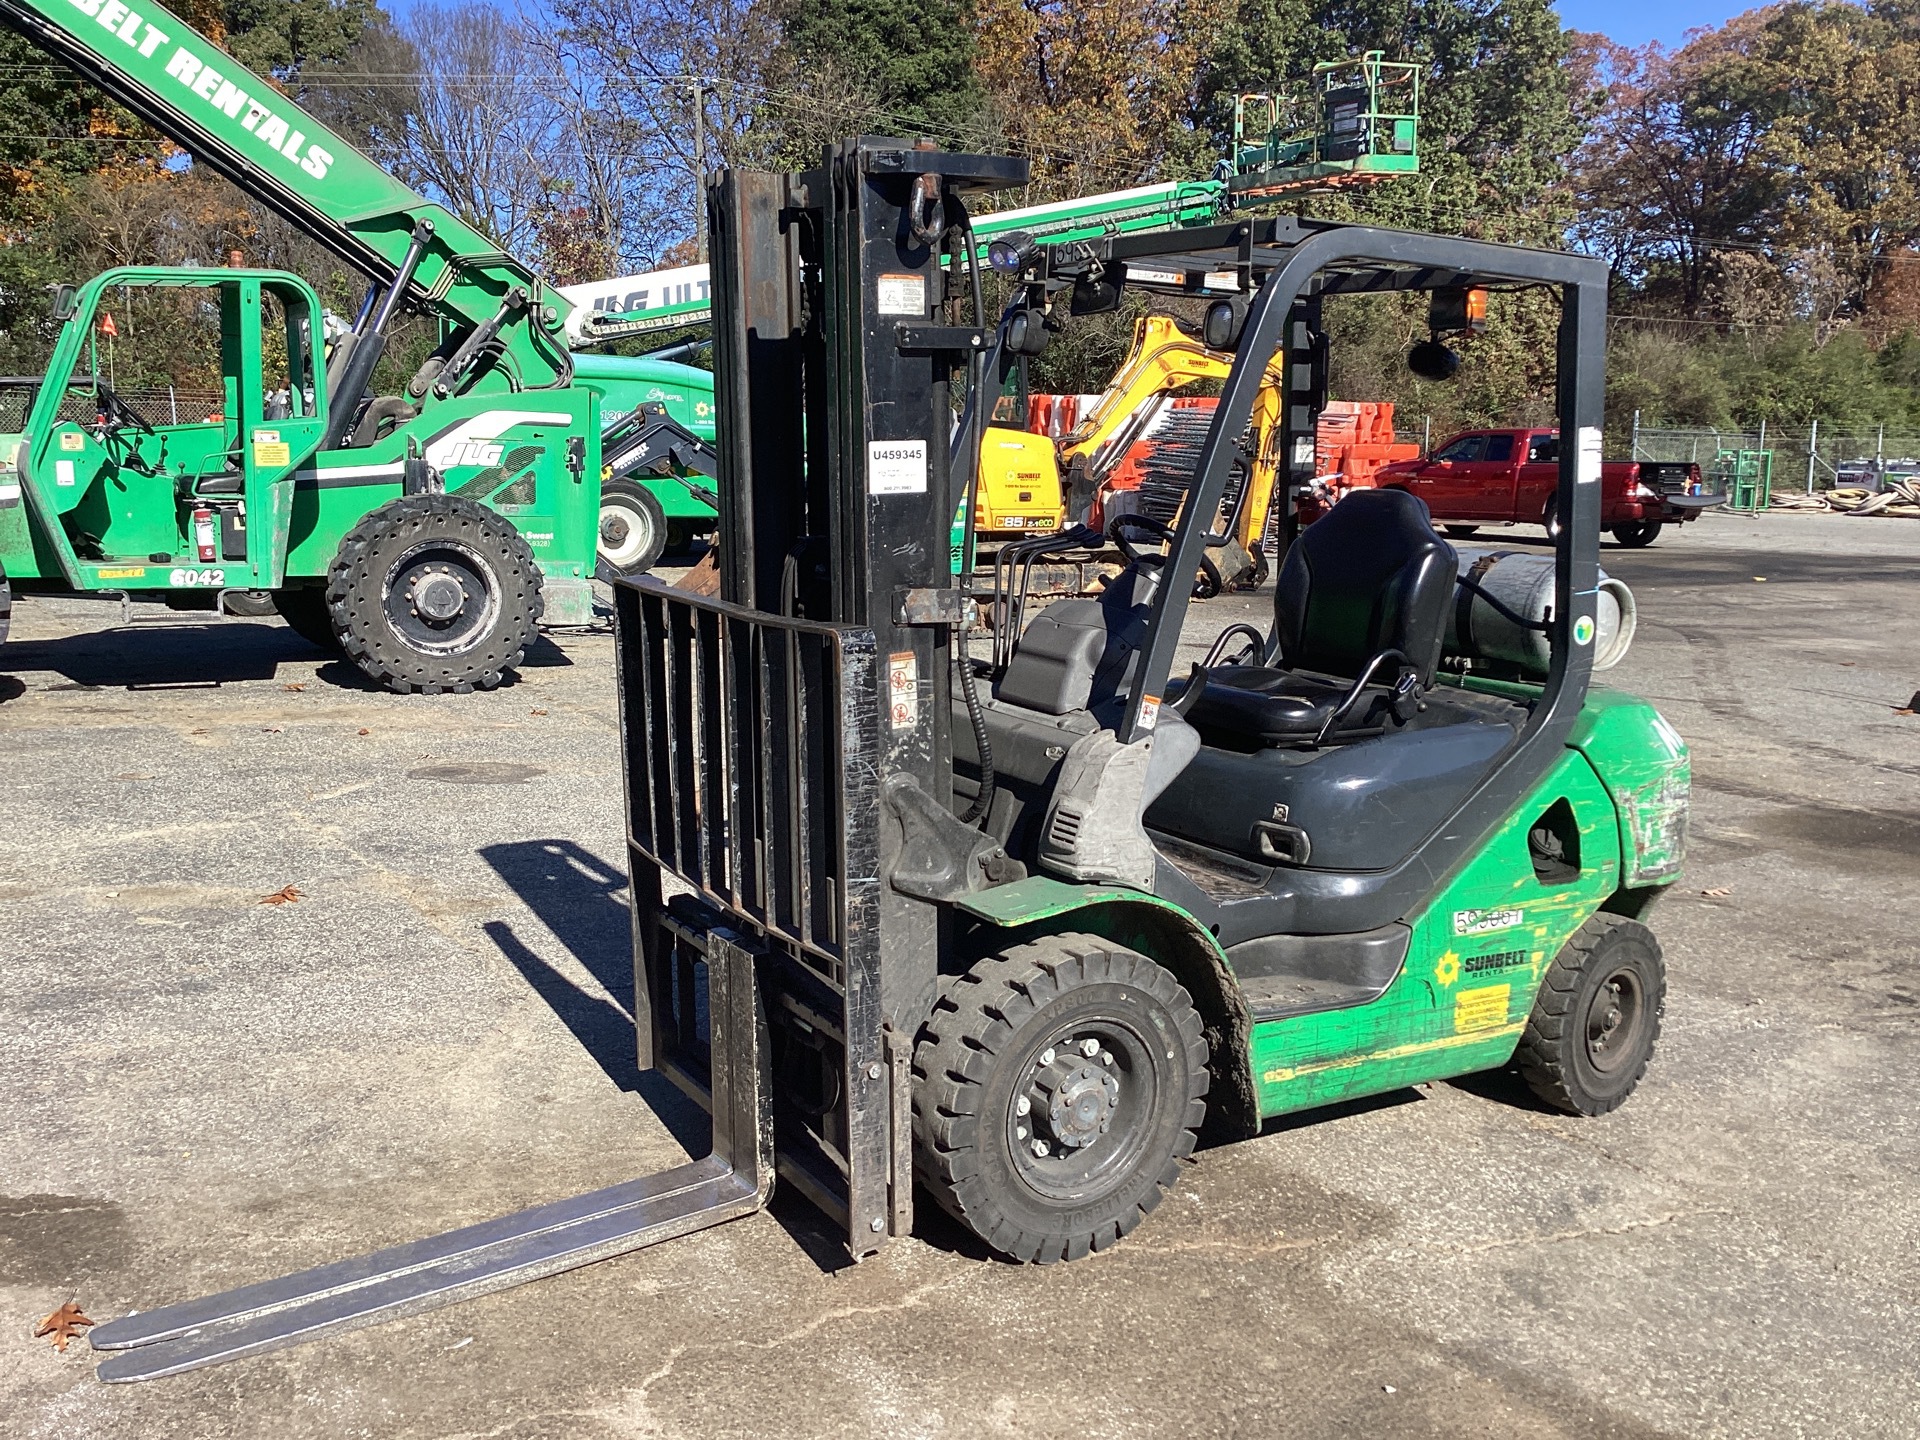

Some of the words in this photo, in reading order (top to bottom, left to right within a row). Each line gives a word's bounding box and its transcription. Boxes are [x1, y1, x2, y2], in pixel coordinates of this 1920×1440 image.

[67, 0, 170, 59] ELT
[165, 46, 335, 180] RENTALS
[1056, 241, 1110, 262] 5951
[441, 443, 505, 467] JLG
[873, 449, 922, 460] U459345
[170, 568, 225, 588] 6042
[1465, 950, 1527, 973] SUNBELT
[1472, 969, 1508, 978] RENTA
